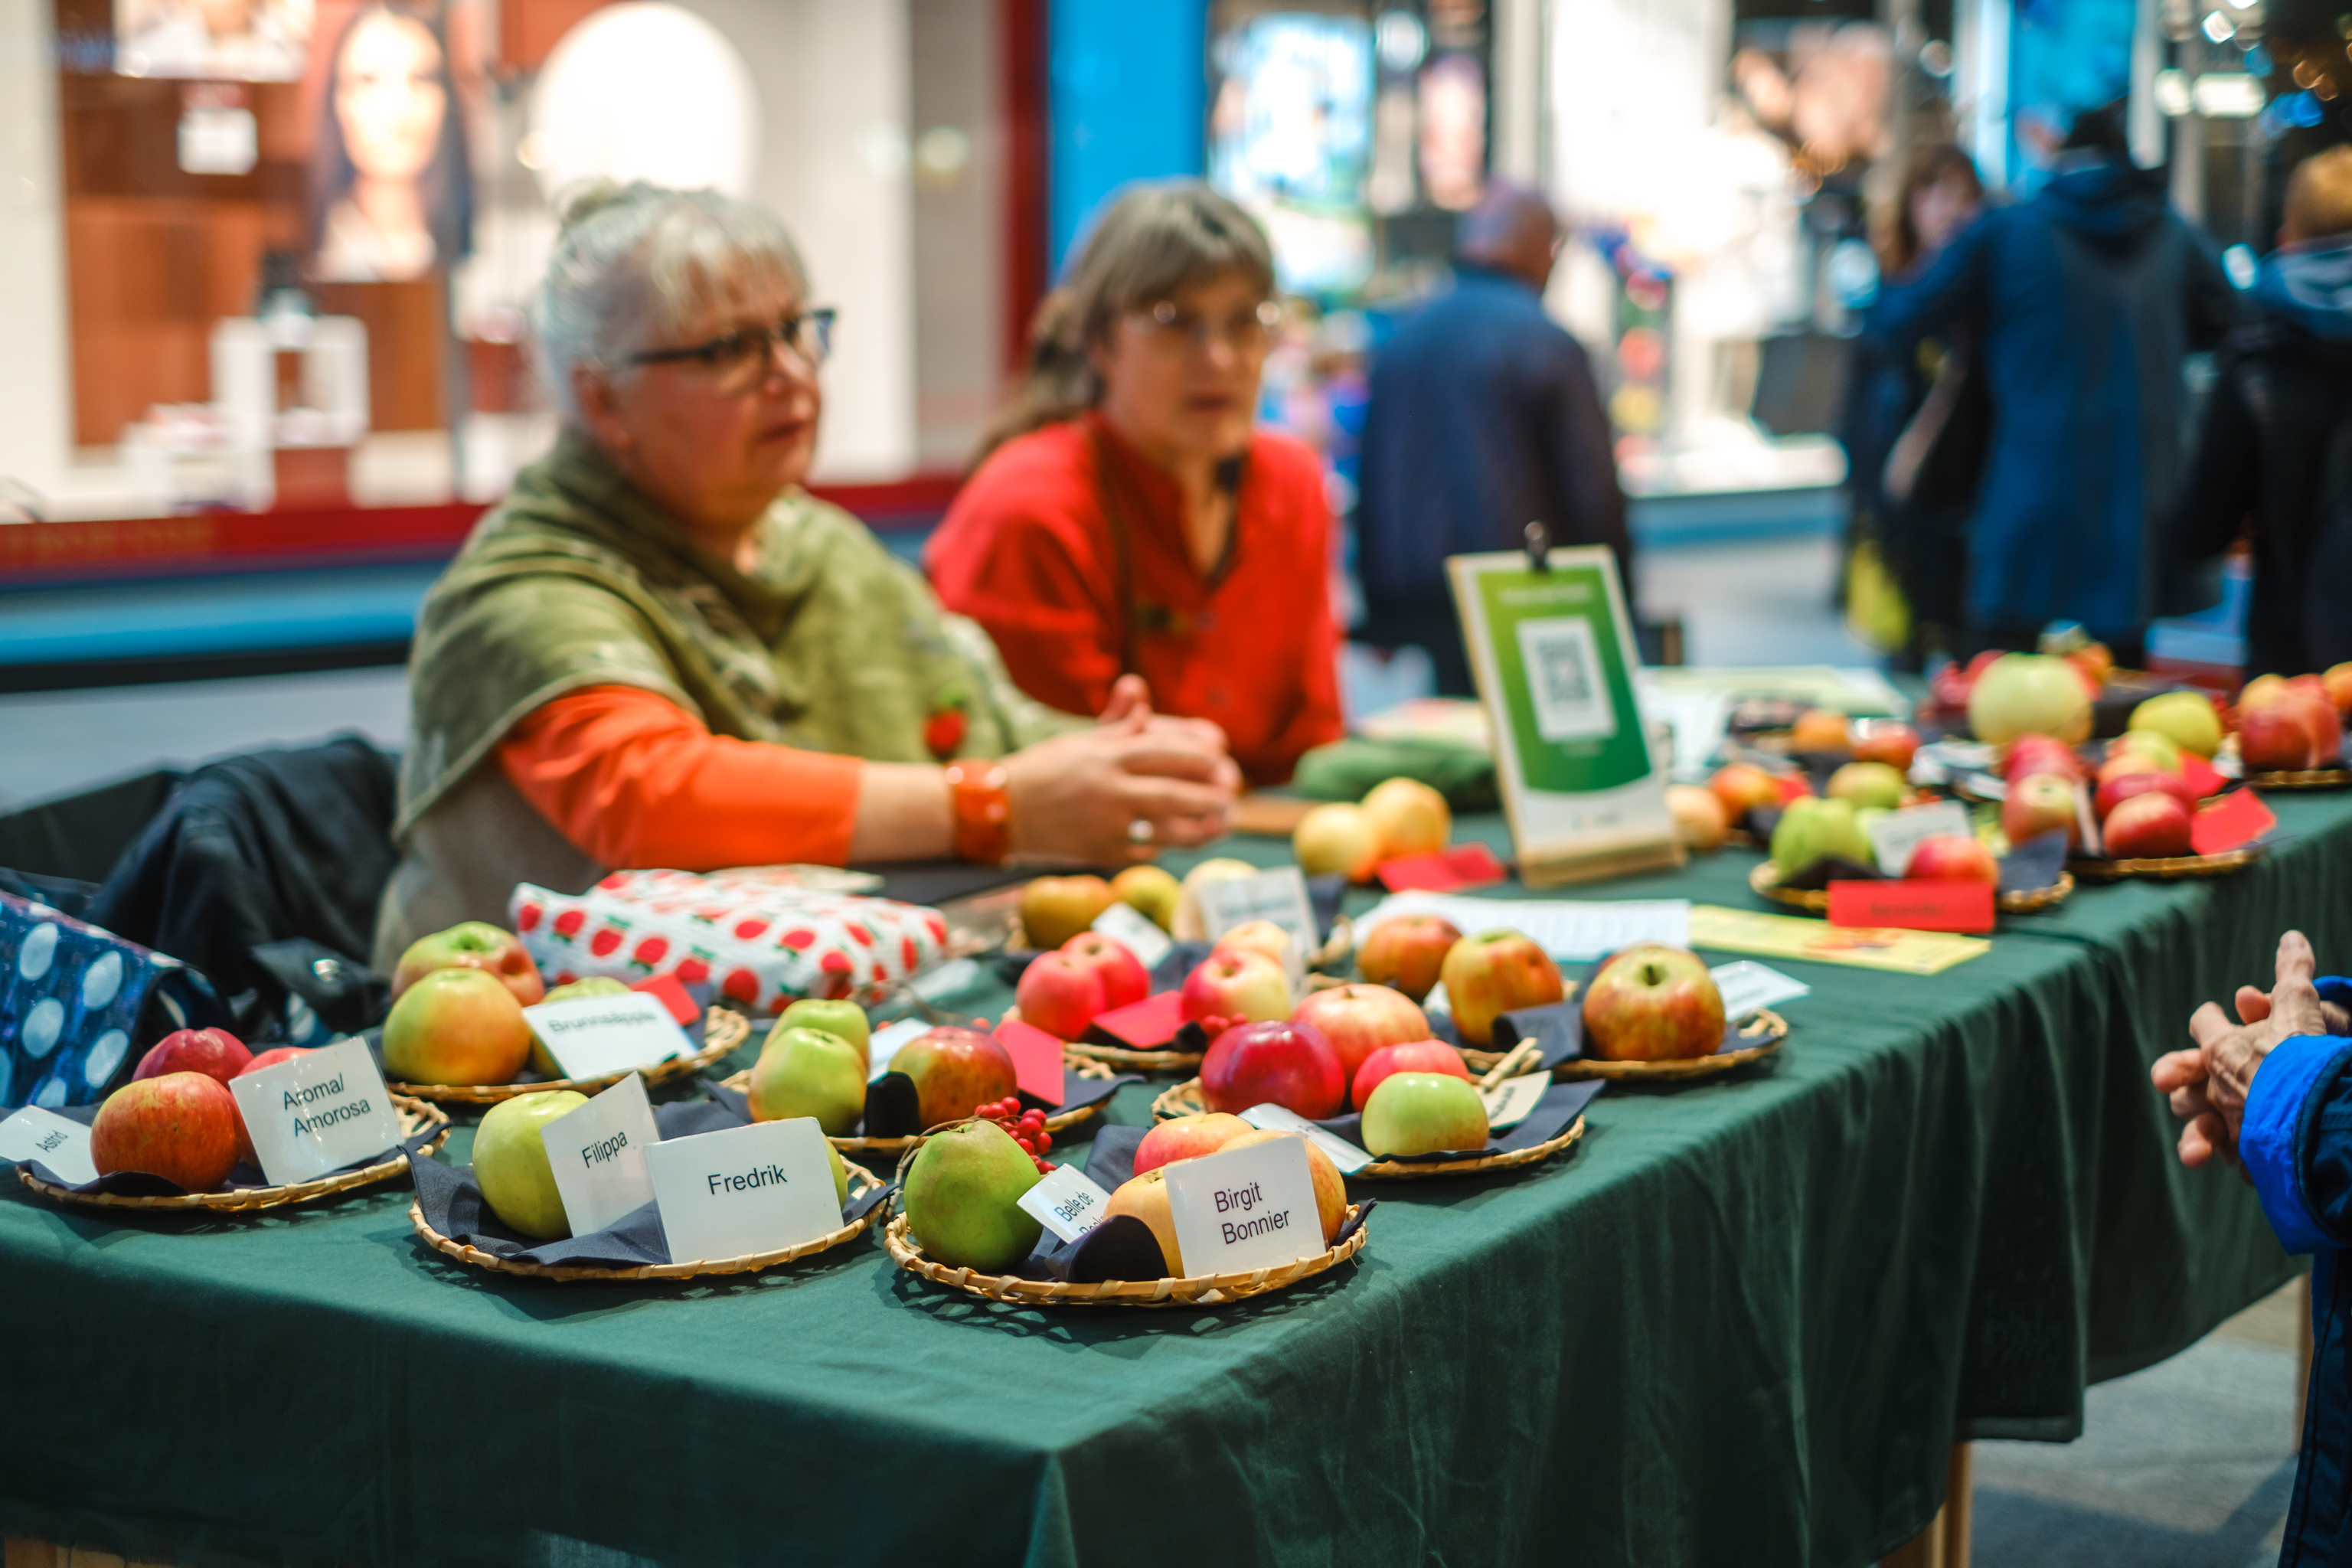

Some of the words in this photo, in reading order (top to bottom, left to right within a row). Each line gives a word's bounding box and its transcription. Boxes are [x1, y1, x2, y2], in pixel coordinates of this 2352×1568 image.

[284, 1072, 344, 1110] Aroma/
[295, 1099, 371, 1137] Amorosa
[35, 1129, 68, 1153] Astrid
[582, 1132, 628, 1168] Filippa
[707, 1164, 788, 1195] Fredrik
[1054, 1198, 1085, 1222] Belle
[1075, 1191, 1094, 1206] de
[1214, 1181, 1263, 1213] Birgit
[1221, 1210, 1289, 1244] Bonnier
